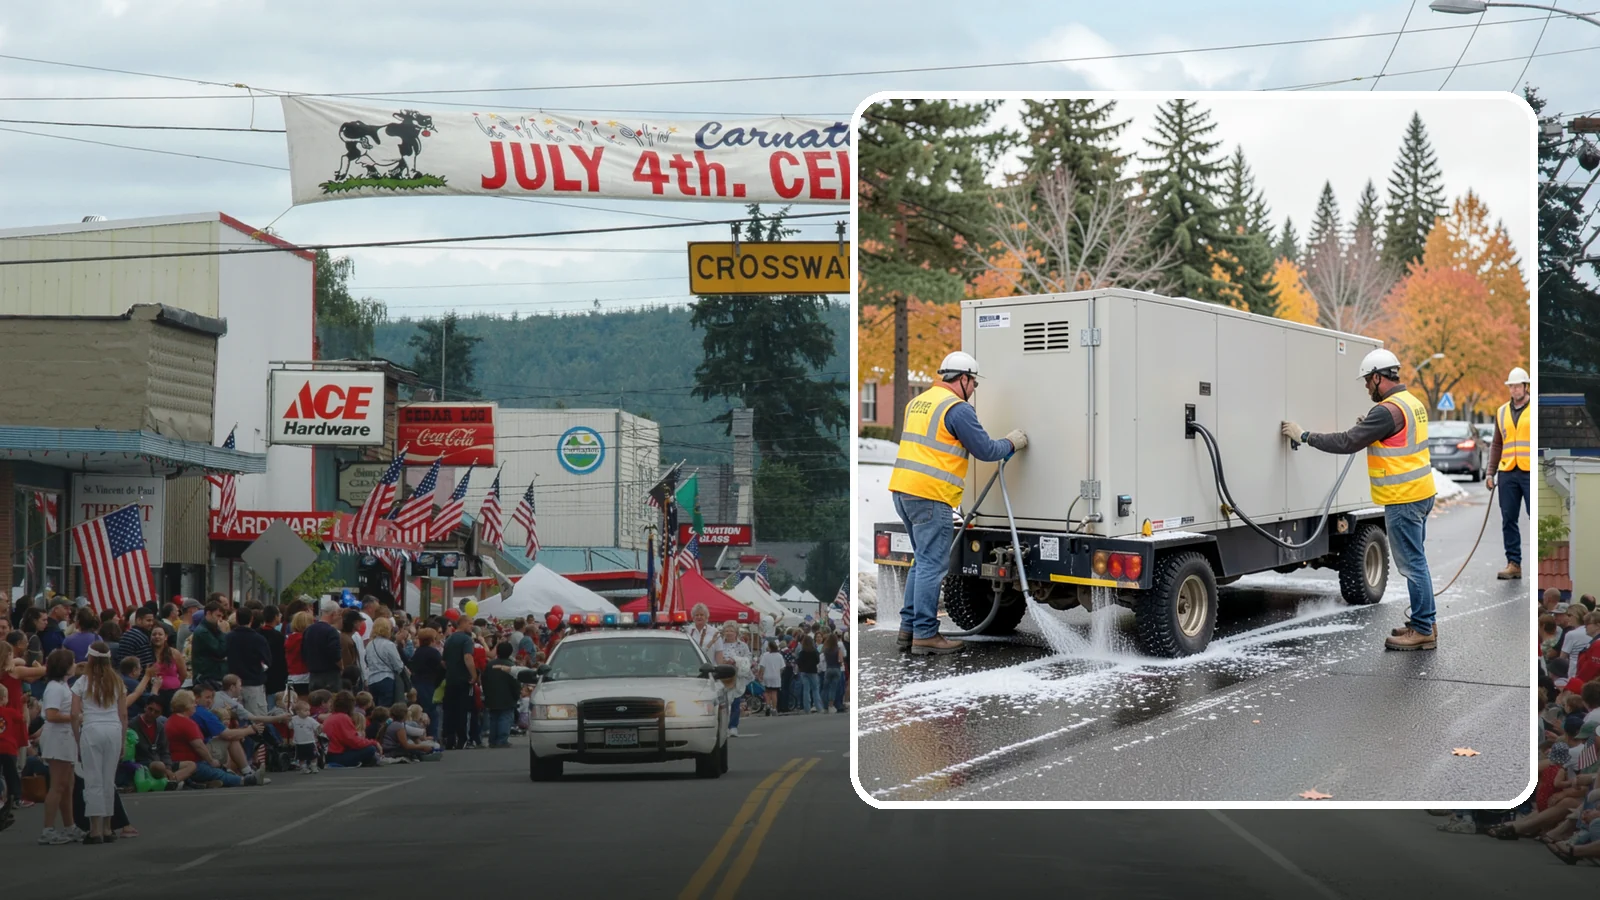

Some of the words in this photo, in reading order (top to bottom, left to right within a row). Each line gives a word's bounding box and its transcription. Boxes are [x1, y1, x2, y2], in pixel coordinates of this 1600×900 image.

[695, 121, 850, 150] Carnat
[481, 141, 604, 192] JULY
[632, 150, 746, 198] 4th.
[697, 254, 850, 280] CROSSWA
[283, 380, 373, 420] ACE
[405, 409, 453, 422] CEDAR
[461, 408, 485, 421] LOG
[283, 421, 371, 437] Hardware
[353, 467, 386, 480] Simpl
[95, 485, 124, 495] Vincent
[126, 486, 135, 494] de
[138, 486, 155, 495] Paul
[213, 516, 331, 535] HARDARE
[688, 527, 741, 535] CRNATION
[699, 535, 730, 543] GLASS
